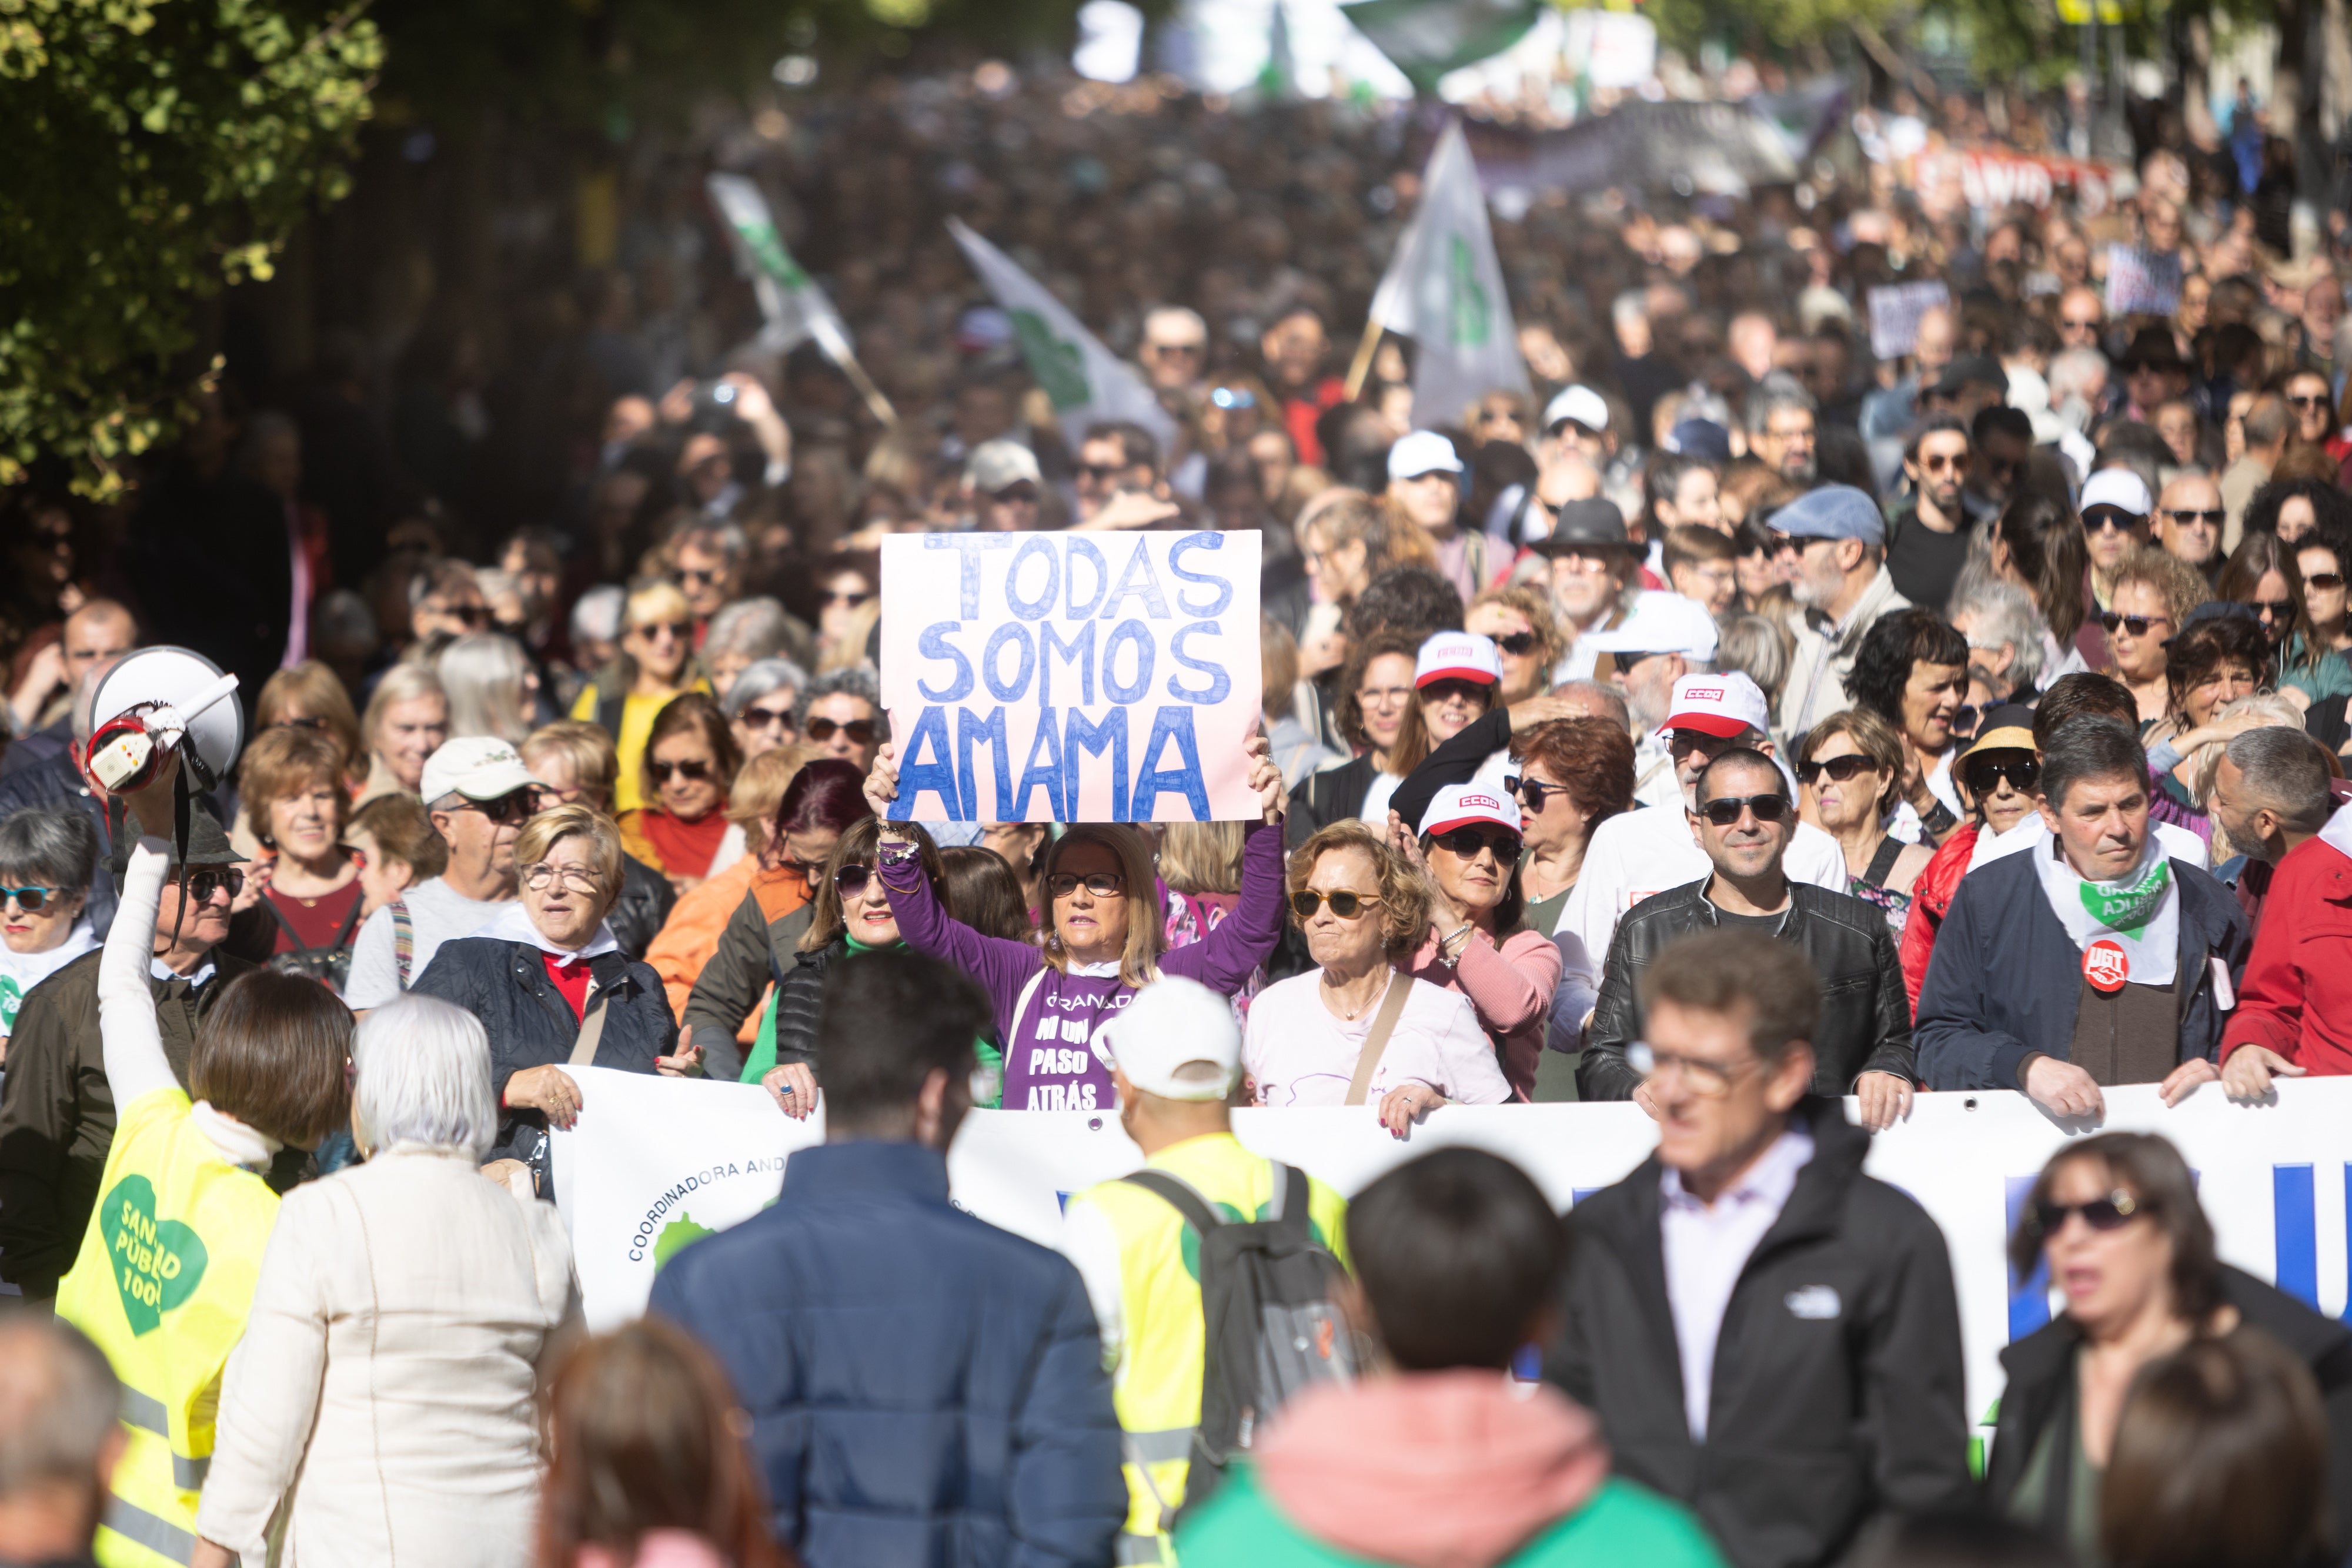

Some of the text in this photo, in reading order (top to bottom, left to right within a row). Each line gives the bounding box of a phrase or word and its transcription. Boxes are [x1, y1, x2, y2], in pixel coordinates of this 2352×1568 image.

[923, 531, 1233, 621] TODAS
[917, 620, 1231, 706] SOMOS
[1686, 689, 1723, 700] CCOO
[886, 706, 1211, 823] AMAMA
[1461, 796, 1498, 808] CCOO
[2089, 946, 2124, 971] UGT
[1035, 1015, 1088, 1044] NI UN
[1029, 1048, 1088, 1075] PASO
[1027, 1079, 1097, 1111] ATRÁS
[629, 1163, 740, 1262] COORDINADORA
